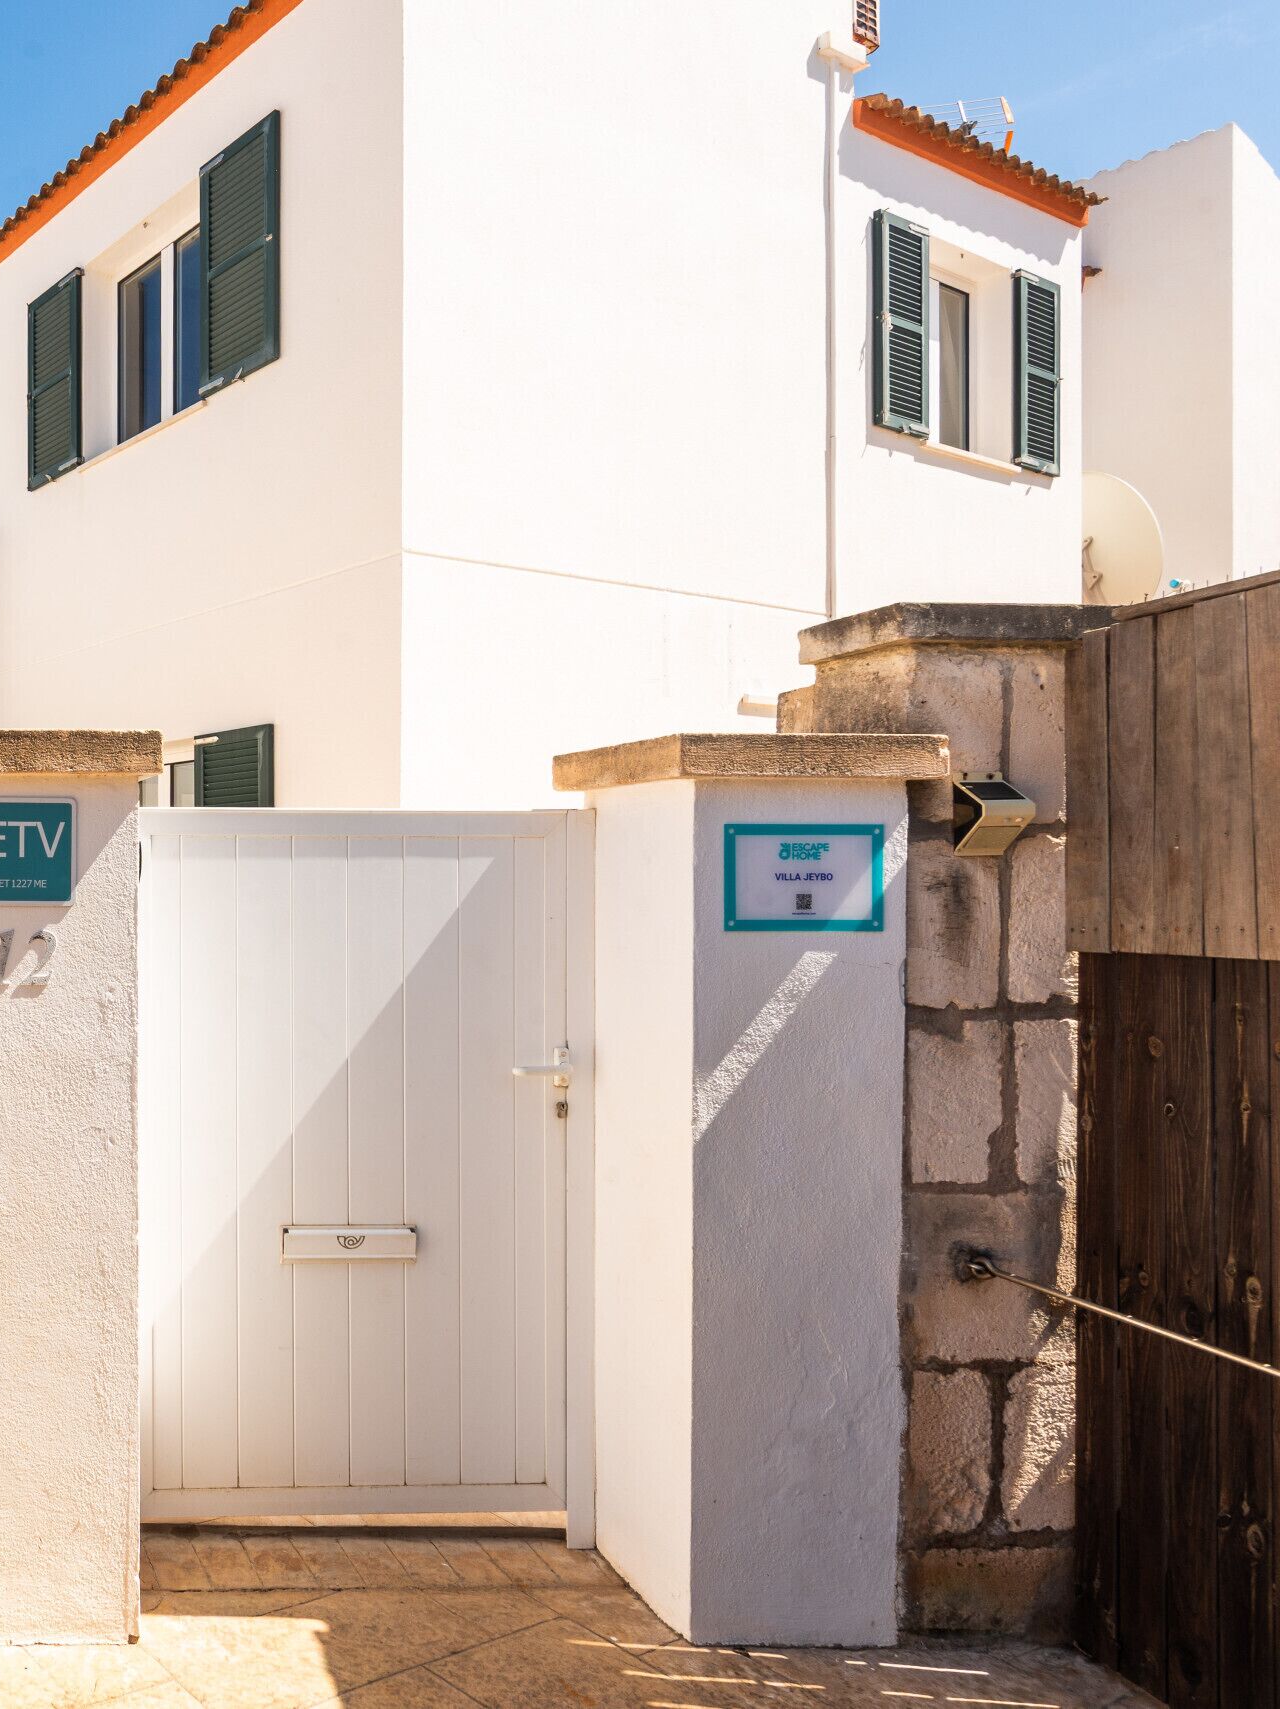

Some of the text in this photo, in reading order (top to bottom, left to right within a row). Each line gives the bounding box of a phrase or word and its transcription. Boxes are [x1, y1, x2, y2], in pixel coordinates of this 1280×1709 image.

[791, 842, 830, 852] ESCAPE
[791, 851, 822, 861] HOME
[774, 872, 834, 881] VILLA JEYBO
[11, 879, 33, 888] 1227
[33, 879, 48, 888] ME
